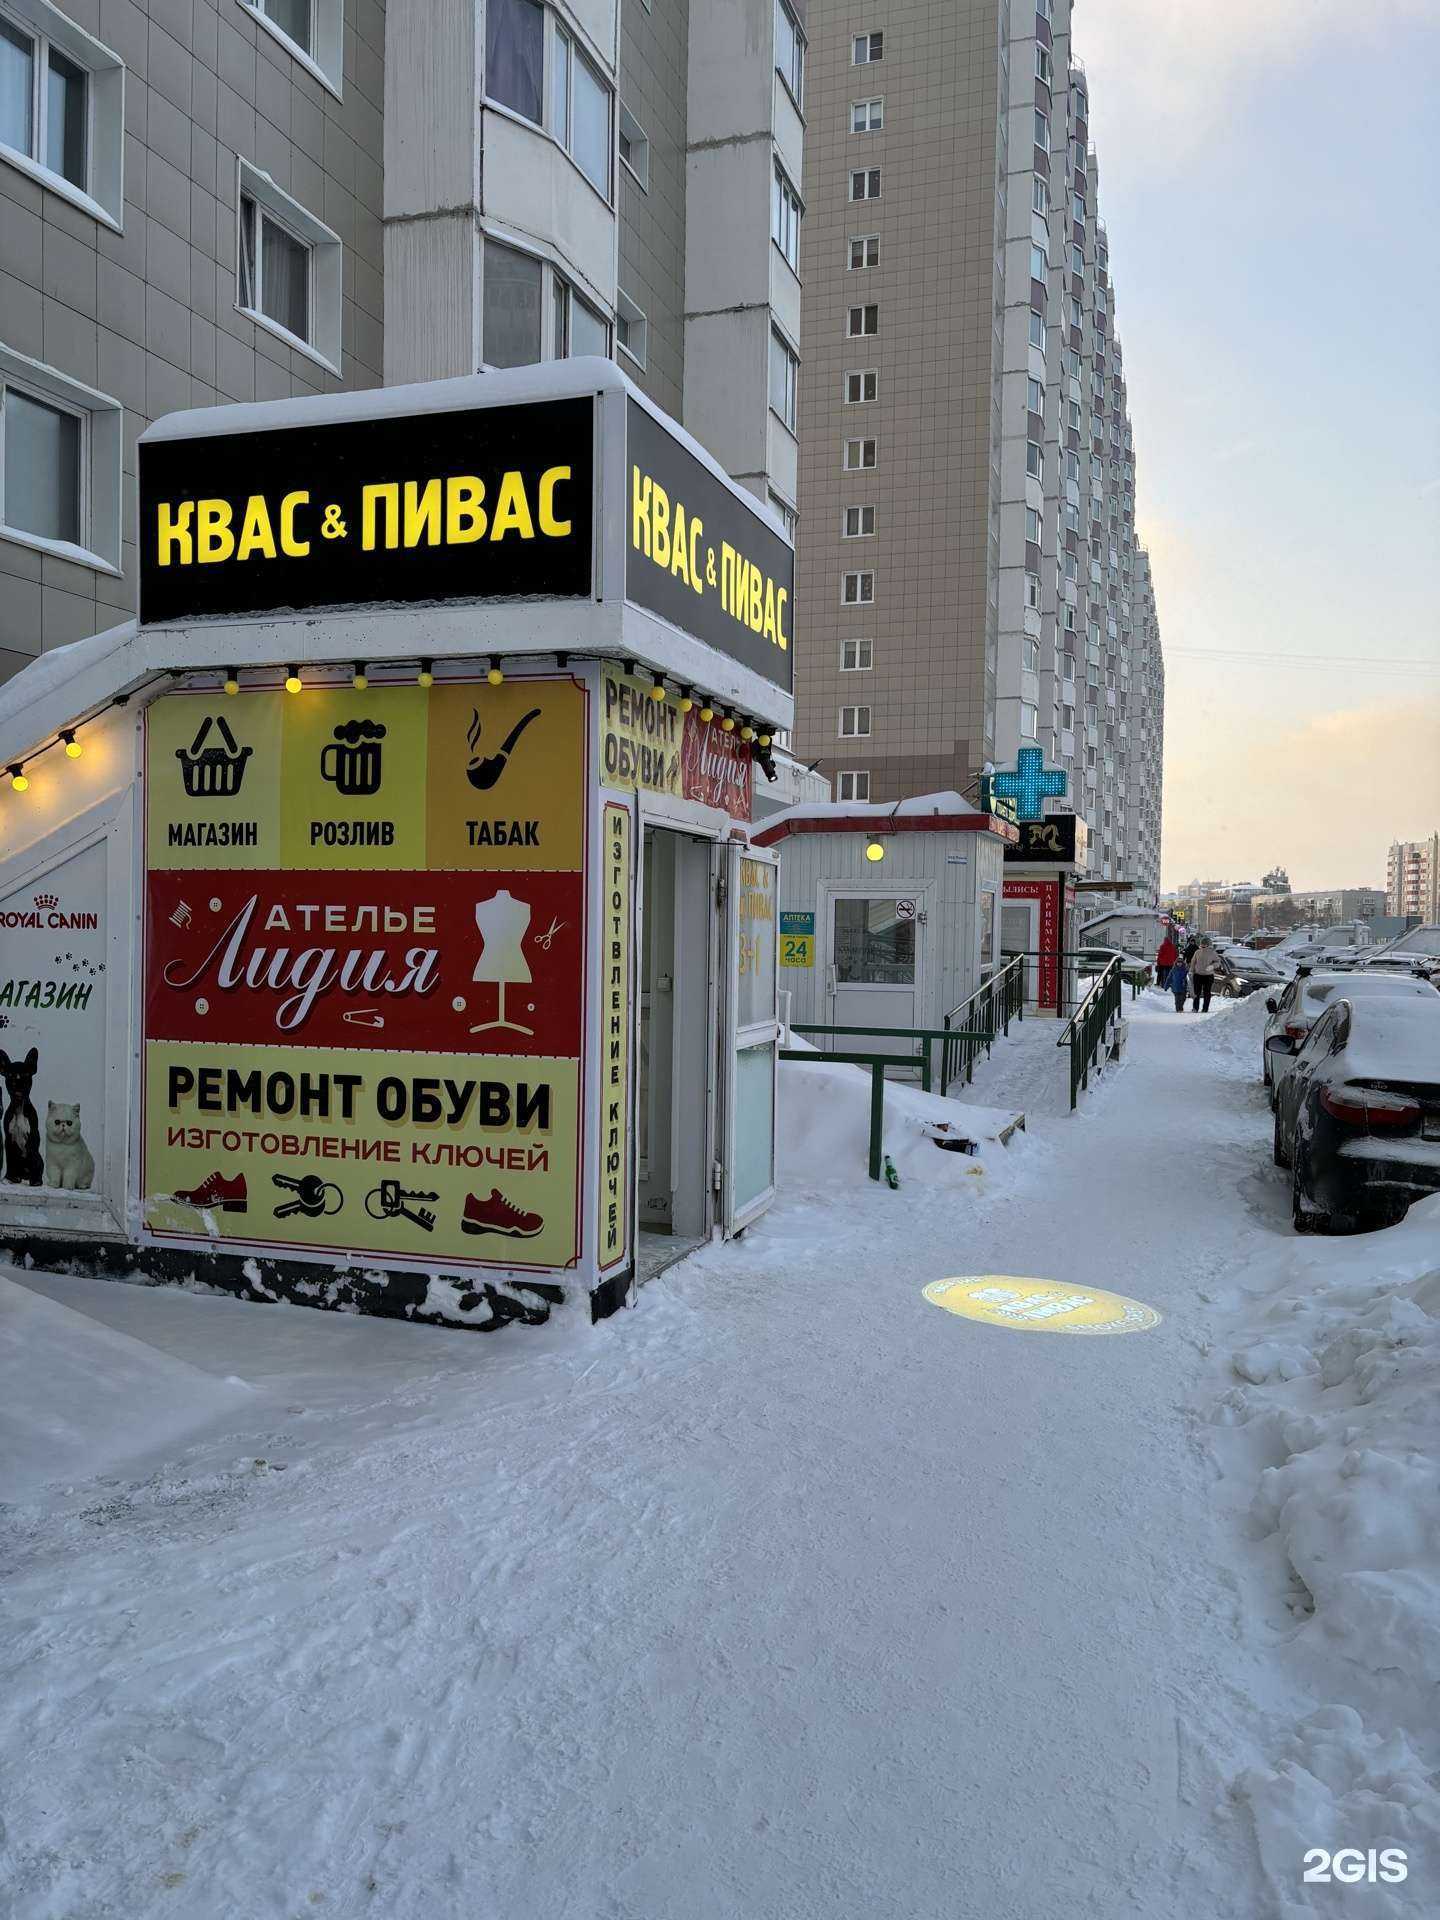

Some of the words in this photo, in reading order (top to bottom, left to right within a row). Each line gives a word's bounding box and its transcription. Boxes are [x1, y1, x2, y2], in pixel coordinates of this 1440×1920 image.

[157, 490, 310, 566] КВАС
[321, 503, 348, 540] &
[361, 465, 572, 551] ПИВАС
[632, 463, 703, 594] КВАС
[706, 546, 717, 588] &
[721, 540, 787, 650] ПИВАС
[605, 677, 677, 743] РЕМОНТ
[605, 733, 665, 788] ОБУВИ
[688, 720, 748, 802] Лидия
[168, 821, 258, 847] МАГАЗИН
[310, 821, 395, 846] РОЗЛИВ
[465, 820, 540, 847] ТАБАК
[47, 911, 98, 930] CANIN
[264, 903, 437, 934] АТЕЛЬЕ
[784, 940, 807, 957] 24
[163, 893, 441, 1031] Лидия
[610, 816, 622, 1085] ИЗГОТВЛЕНИЕ
[168, 1065, 363, 1122] РЕМОНТ
[377, 1076, 553, 1134] ОБУВИ
[167, 1126, 402, 1162] ИЗГОТОВЛЕНИЕ
[412, 1142, 549, 1172] КЛЮЧЕЙ
[607, 1101, 620, 1250] КЛЮЧЕЙ
